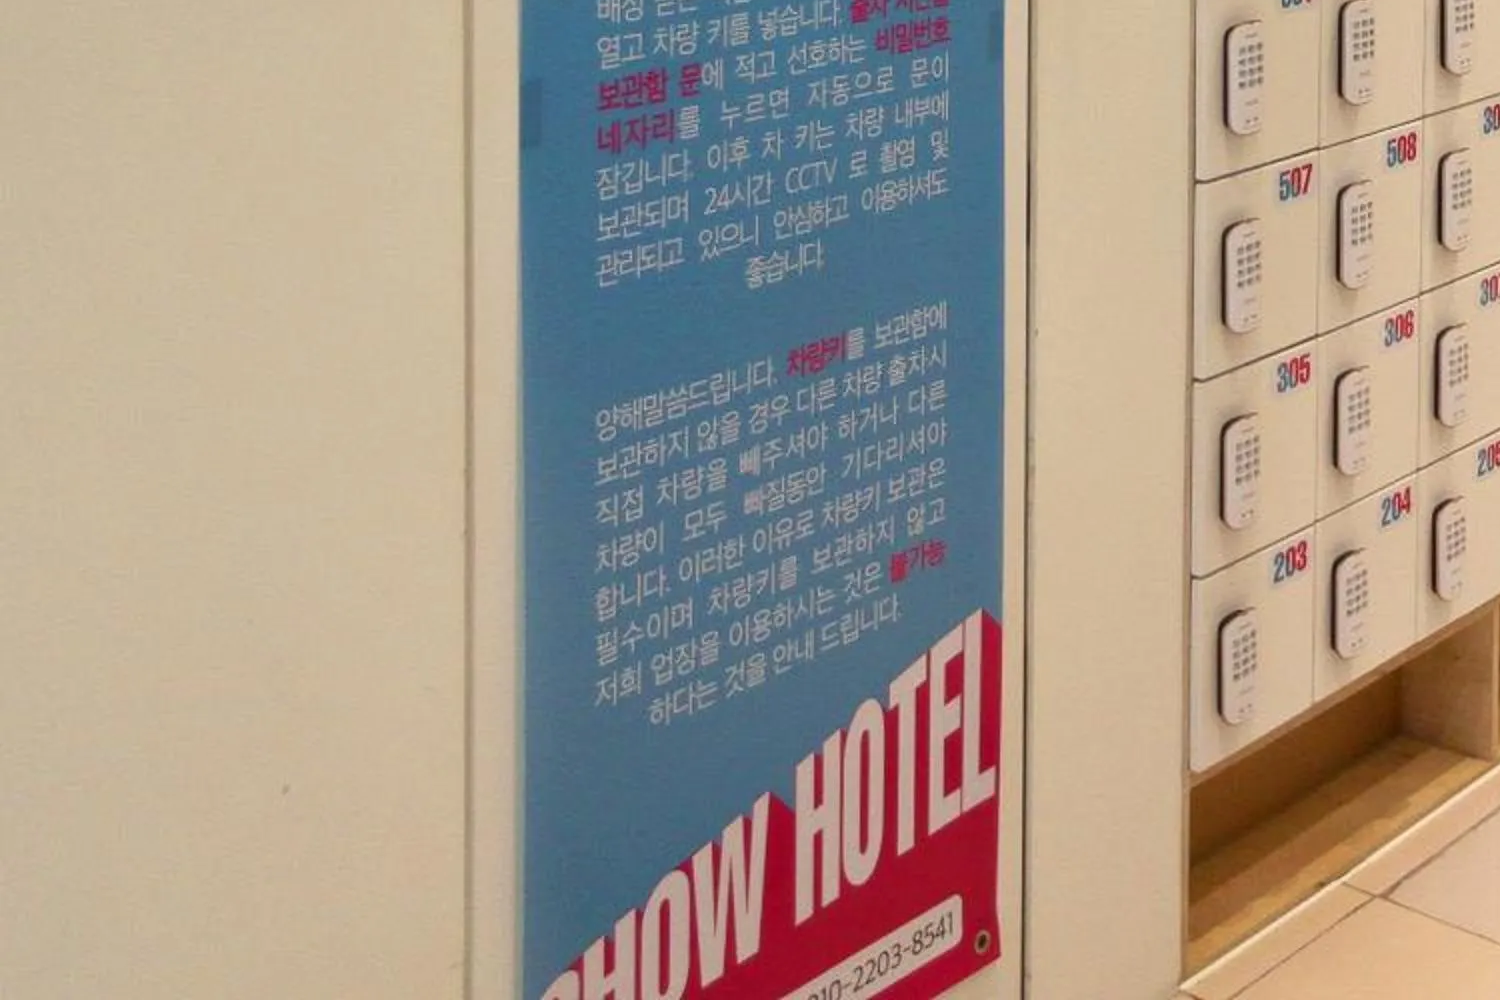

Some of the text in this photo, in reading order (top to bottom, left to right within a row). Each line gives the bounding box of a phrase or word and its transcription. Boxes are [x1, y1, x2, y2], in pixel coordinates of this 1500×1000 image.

[597, 32, 646, 70] 열고
[653, 20, 700, 57] 차량
[707, 12, 750, 47] 키를
[597, 16, 951, 111] 보관함 문에 적고 선호하는 비밀번호
[597, 49, 949, 153] 네자리를 누르면 자동으로 문이
[707, 135, 751, 172] 이후
[761, 127, 783, 160] 차
[795, 120, 835, 152] 키는
[845, 105, 885, 140] 차량
[895, 89, 949, 128] 내부에
[1387, 132, 1417, 168] 508
[595, 168, 951, 288] 관리되고 있으니 안심하고 이용하셔도
[597, 190, 689, 241] 보관되며
[703, 171, 773, 215] 24시간
[785, 157, 838, 193] CCTV
[880, 136, 915, 173] 촬영
[931, 128, 949, 161] 및
[1279, 164, 1313, 201] 507
[596, 300, 947, 442] 양해말씀드립니다. 차량키를 보관함에
[1276, 353, 1311, 394] 305
[1384, 310, 1414, 348] 306
[594, 339, 947, 486] 보관하지 않을 경우 다른 차량 출차시
[596, 379, 949, 527] 직접 차량을 빼주셔야 하거나 다른
[594, 519, 664, 573] 차량이
[681, 500, 728, 542] 모두
[841, 416, 948, 480] 기다리셔야
[595, 457, 946, 622] 합니다. 이러한 이유로 차량키 보관은
[1381, 486, 1412, 527] 204
[596, 498, 946, 667] 필수이며 차량키를 보관하지 않고
[1273, 540, 1308, 583] 203
[595, 538, 947, 706] 저희 업장을 이용하시는 것은 불가능
[647, 593, 901, 726] 하다는 것을 안내 드립니다.
[795, 607, 996, 926] HOTEL
[807, 911, 953, 1000] 10-2203-8541
